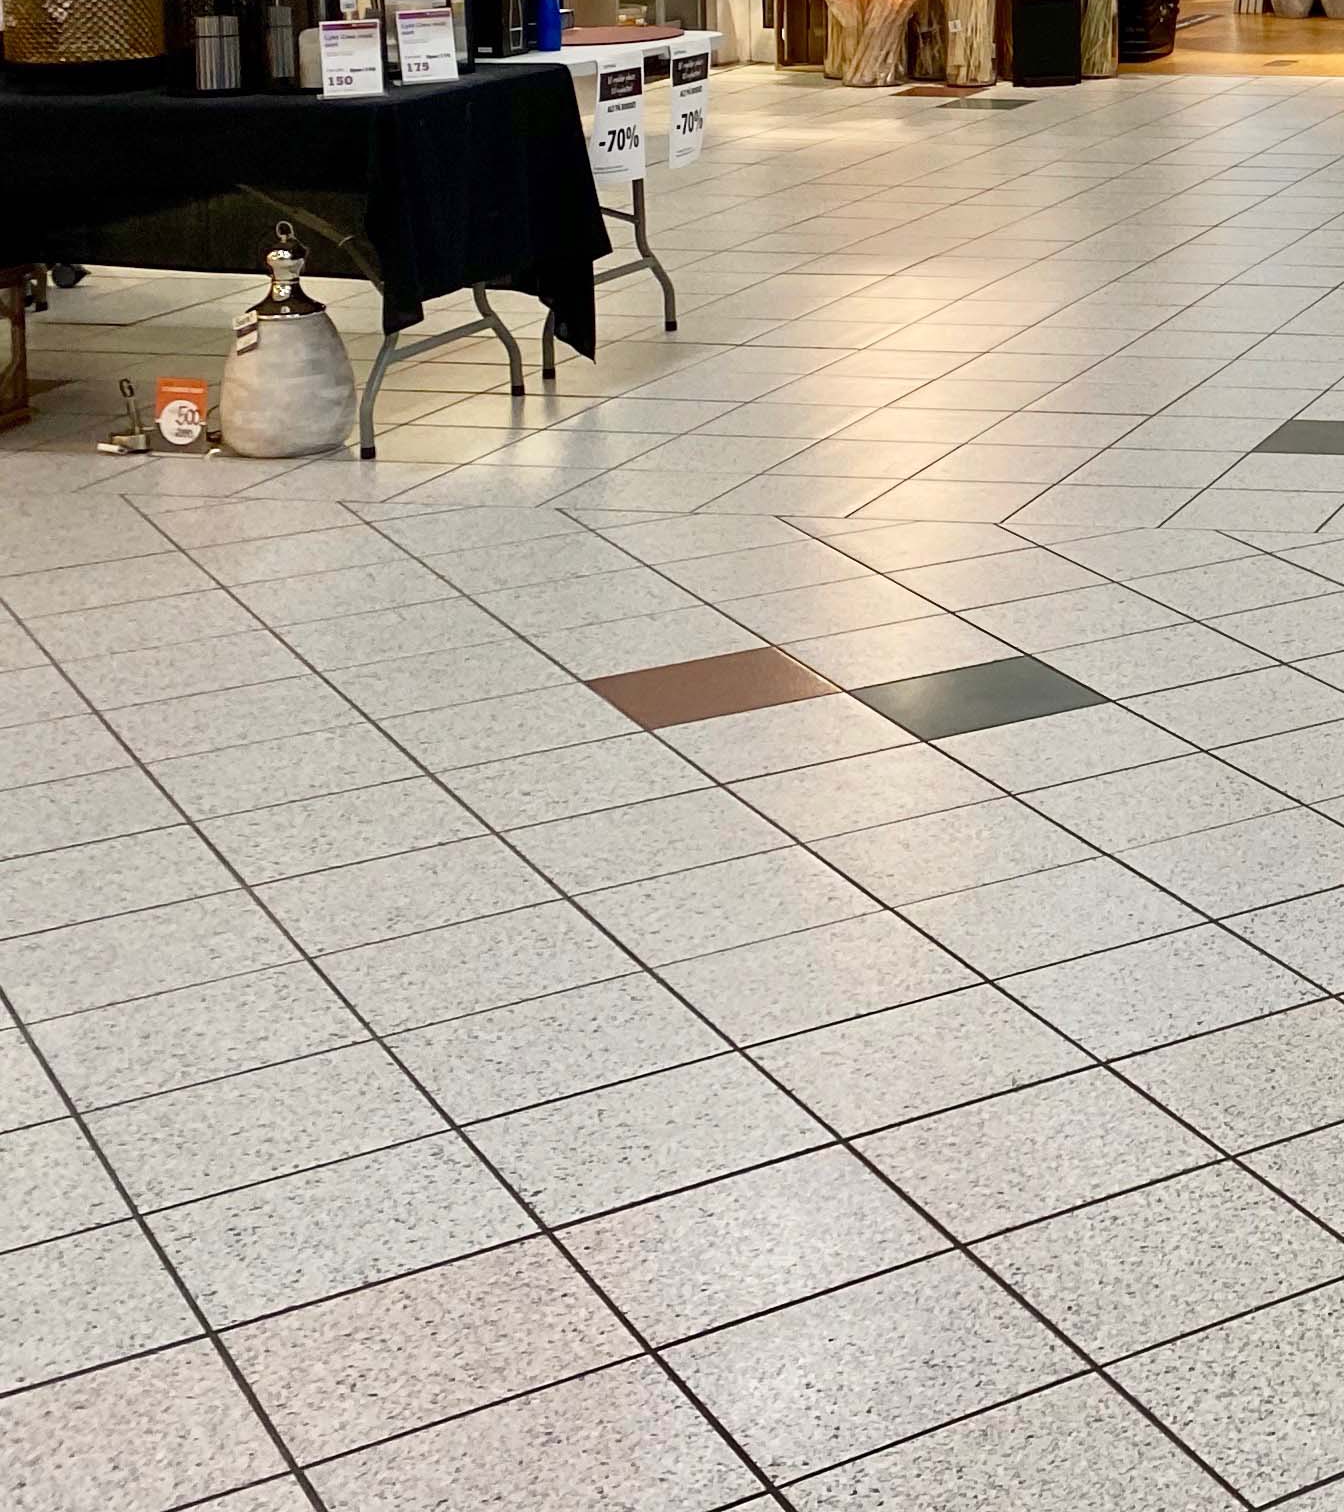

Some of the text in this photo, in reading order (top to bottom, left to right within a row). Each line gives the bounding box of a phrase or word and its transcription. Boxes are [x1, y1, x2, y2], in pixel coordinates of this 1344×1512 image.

[407, 61, 431, 73] 175
[328, 75, 353, 86] 150
[676, 108, 703, 135] -70%
[599, 124, 640, 152] -70%
